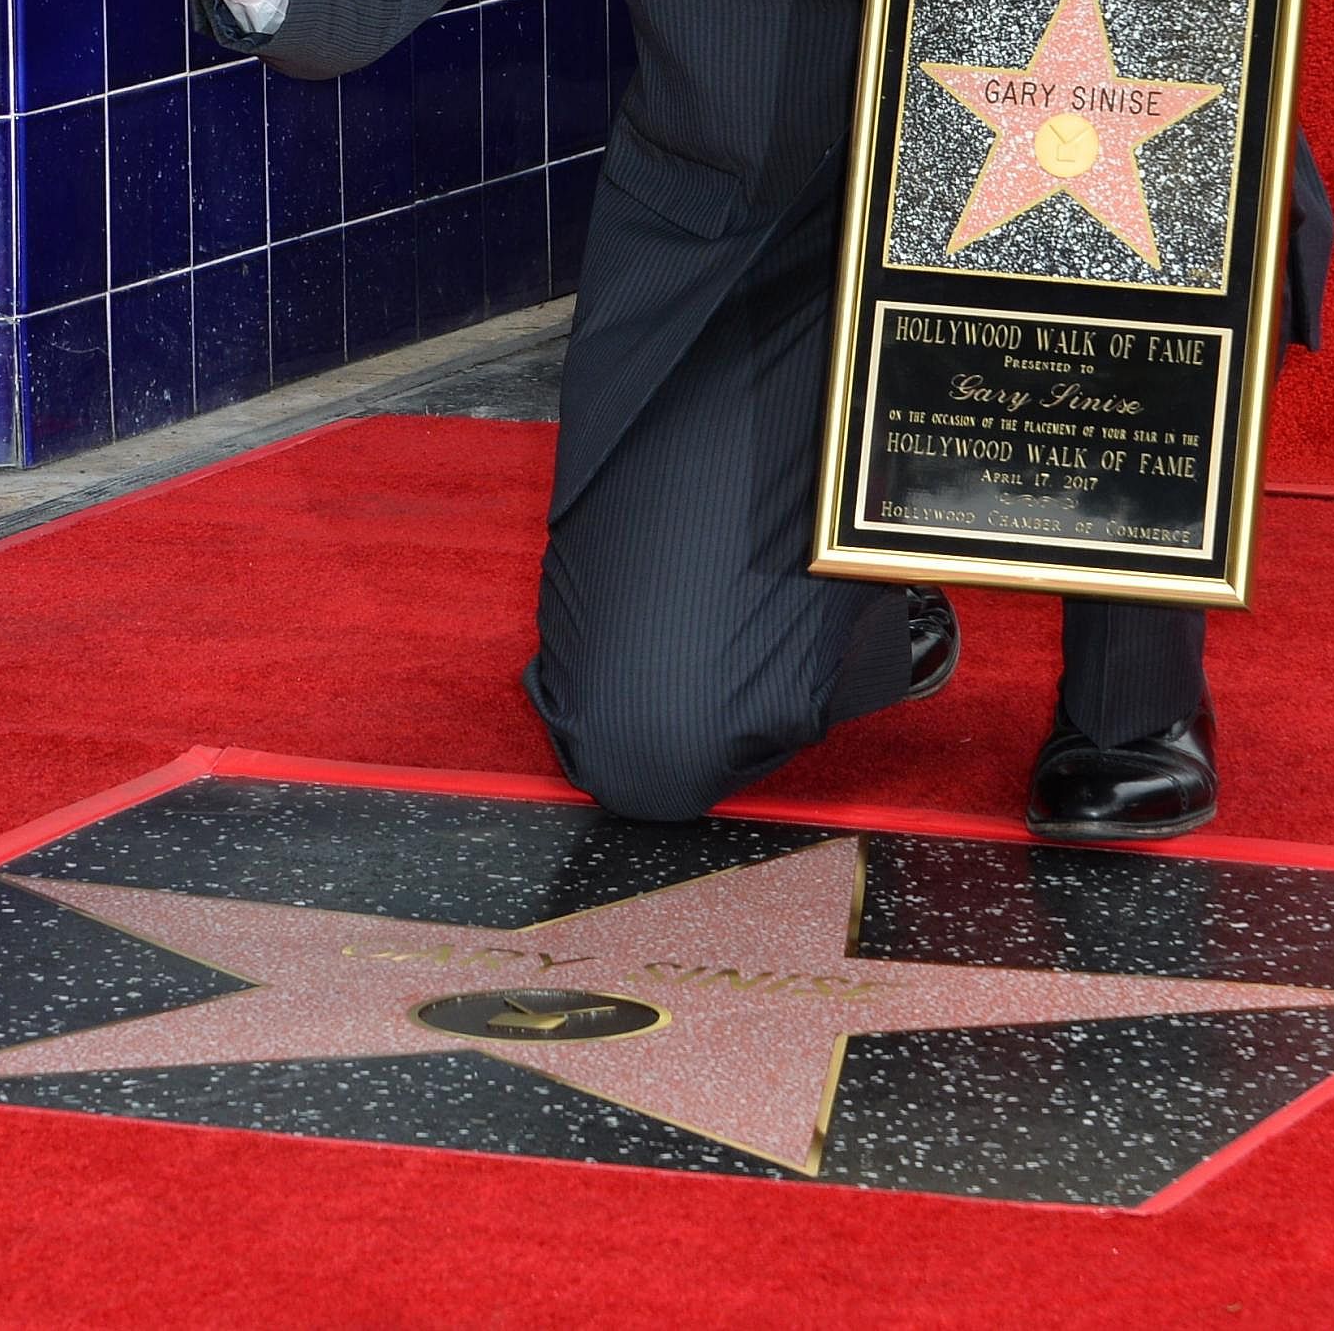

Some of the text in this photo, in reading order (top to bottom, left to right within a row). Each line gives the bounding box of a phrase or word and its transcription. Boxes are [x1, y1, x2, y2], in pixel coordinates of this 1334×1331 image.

[985, 80, 1162, 118] GARY SINISE
[896, 316, 1205, 366] HOLLYWOOD WALK OF FAME
[948, 373, 1145, 415] Gary Sinise
[889, 409, 1200, 447] ON THE OCCASION OF THE PLACEMENT OF YOUR STAR IN THE
[886, 431, 1196, 479] HOLLYWOOD WALK OF FAME
[1063, 475, 1099, 492] 2017
[341, 940, 903, 1002] GARY SINISE
